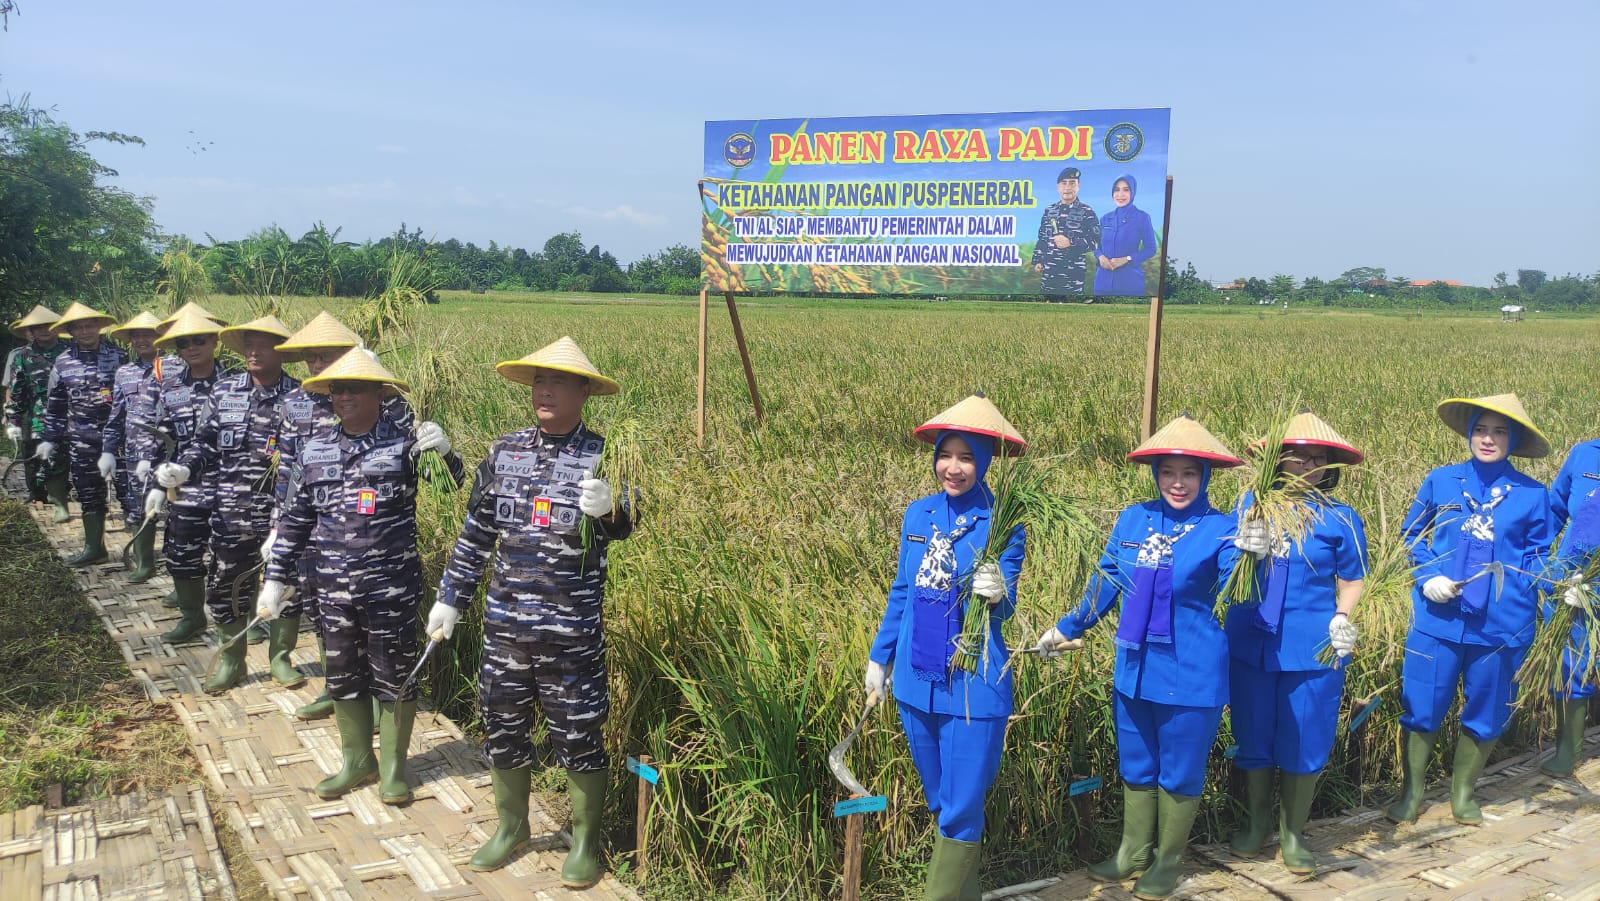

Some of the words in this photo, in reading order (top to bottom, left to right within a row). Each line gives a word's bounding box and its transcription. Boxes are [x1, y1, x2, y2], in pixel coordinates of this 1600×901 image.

[770, 132, 884, 163] PANEN
[893, 129, 989, 161] RAYA
[998, 126, 1091, 159] PADI
[718, 183, 821, 207] KETAHANAN
[825, 182, 897, 207] PANGAN
[902, 180, 1034, 207] PUSPENERBAL
[734, 217, 755, 236] TNI
[757, 217, 774, 236] AL
[776, 217, 805, 236] SIAP
[807, 217, 878, 236] MEMBANTU
[881, 216, 964, 235] PEMERINTAH
[967, 216, 1014, 236] DALAM
[726, 244, 813, 263] MEWUJUDKAN
[816, 244, 892, 263] KETAHANAN
[895, 244, 948, 263] PANGAN
[952, 244, 1020, 264] NASIONAL
[497, 464, 531, 474] BAYU
[556, 471, 574, 481] TNI
